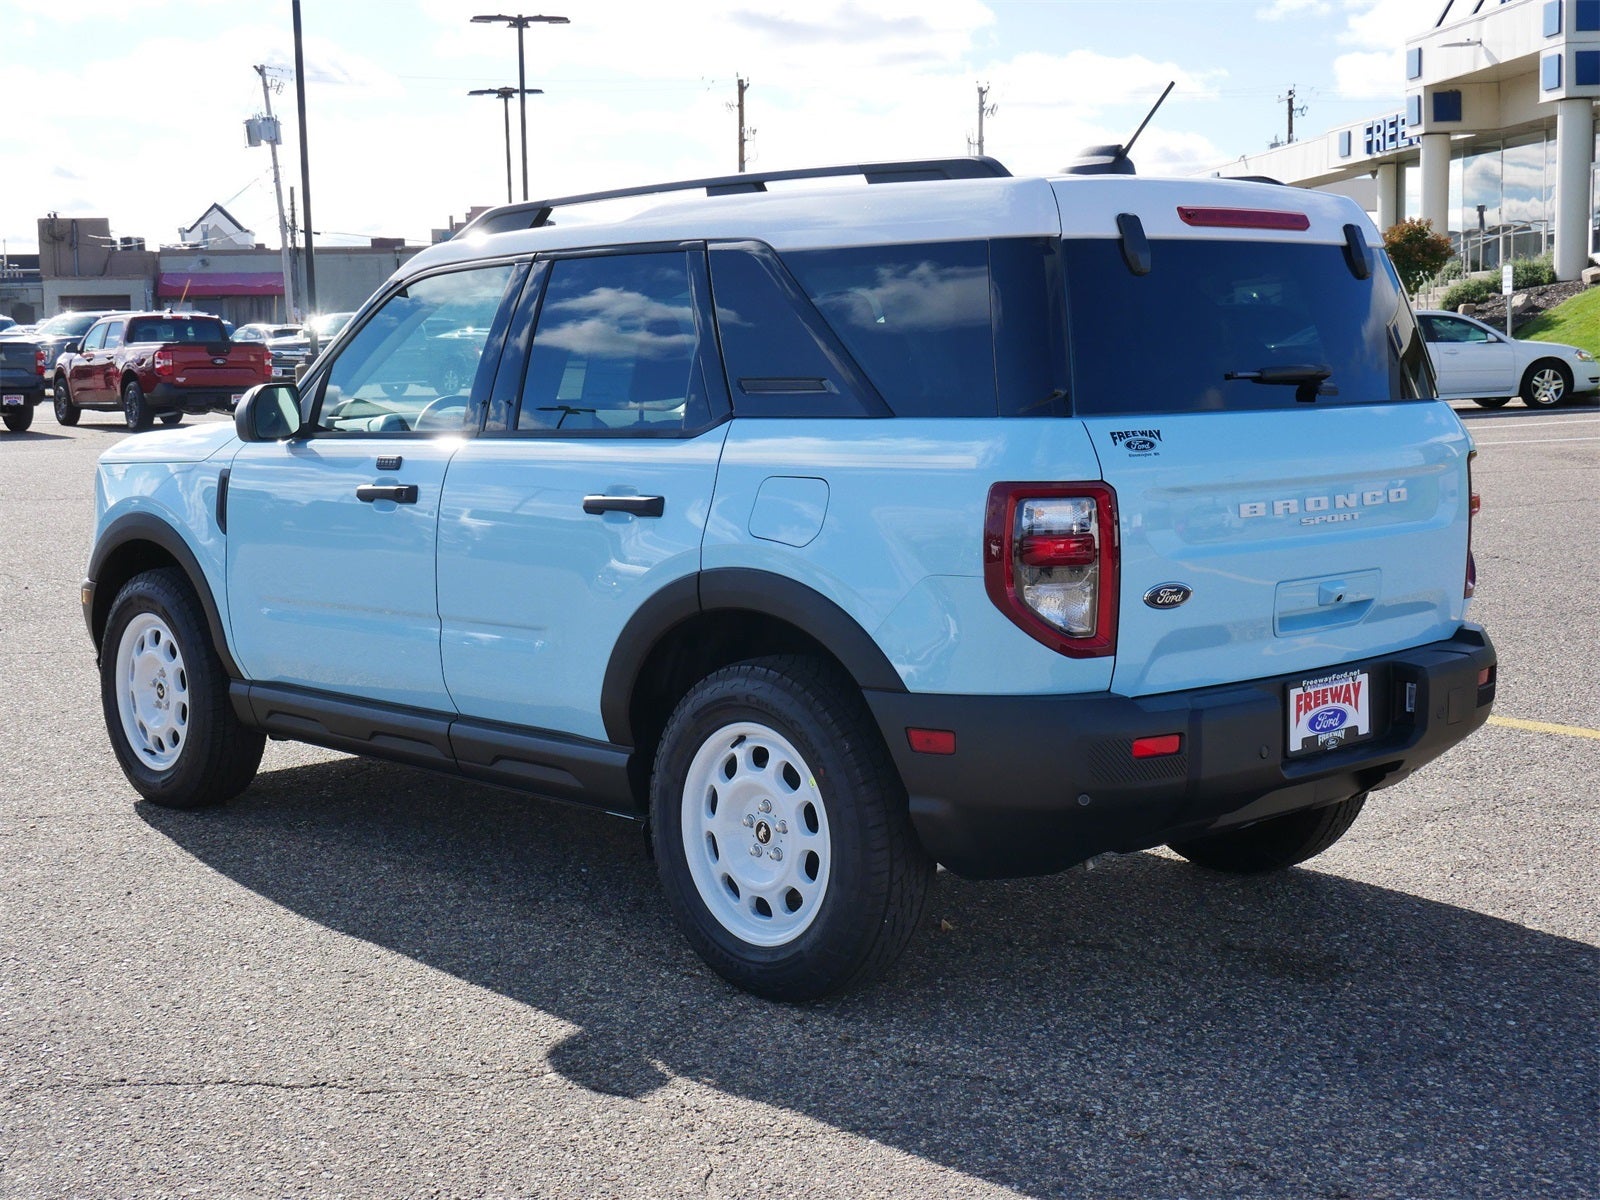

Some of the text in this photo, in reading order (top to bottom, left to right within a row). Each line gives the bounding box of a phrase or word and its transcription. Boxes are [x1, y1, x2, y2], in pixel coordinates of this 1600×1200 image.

[1110, 429, 1162, 446] FREEWAY
[1239, 487, 1408, 518] BRONCO
[1300, 511, 1362, 526] SPORT
[1156, 588, 1184, 604] Ford
[1302, 669, 1360, 687] FreewayFord.net
[1295, 681, 1362, 729] FREEWAY
[1315, 711, 1341, 731] Ford
[1317, 729, 1346, 747] FREEWAY
